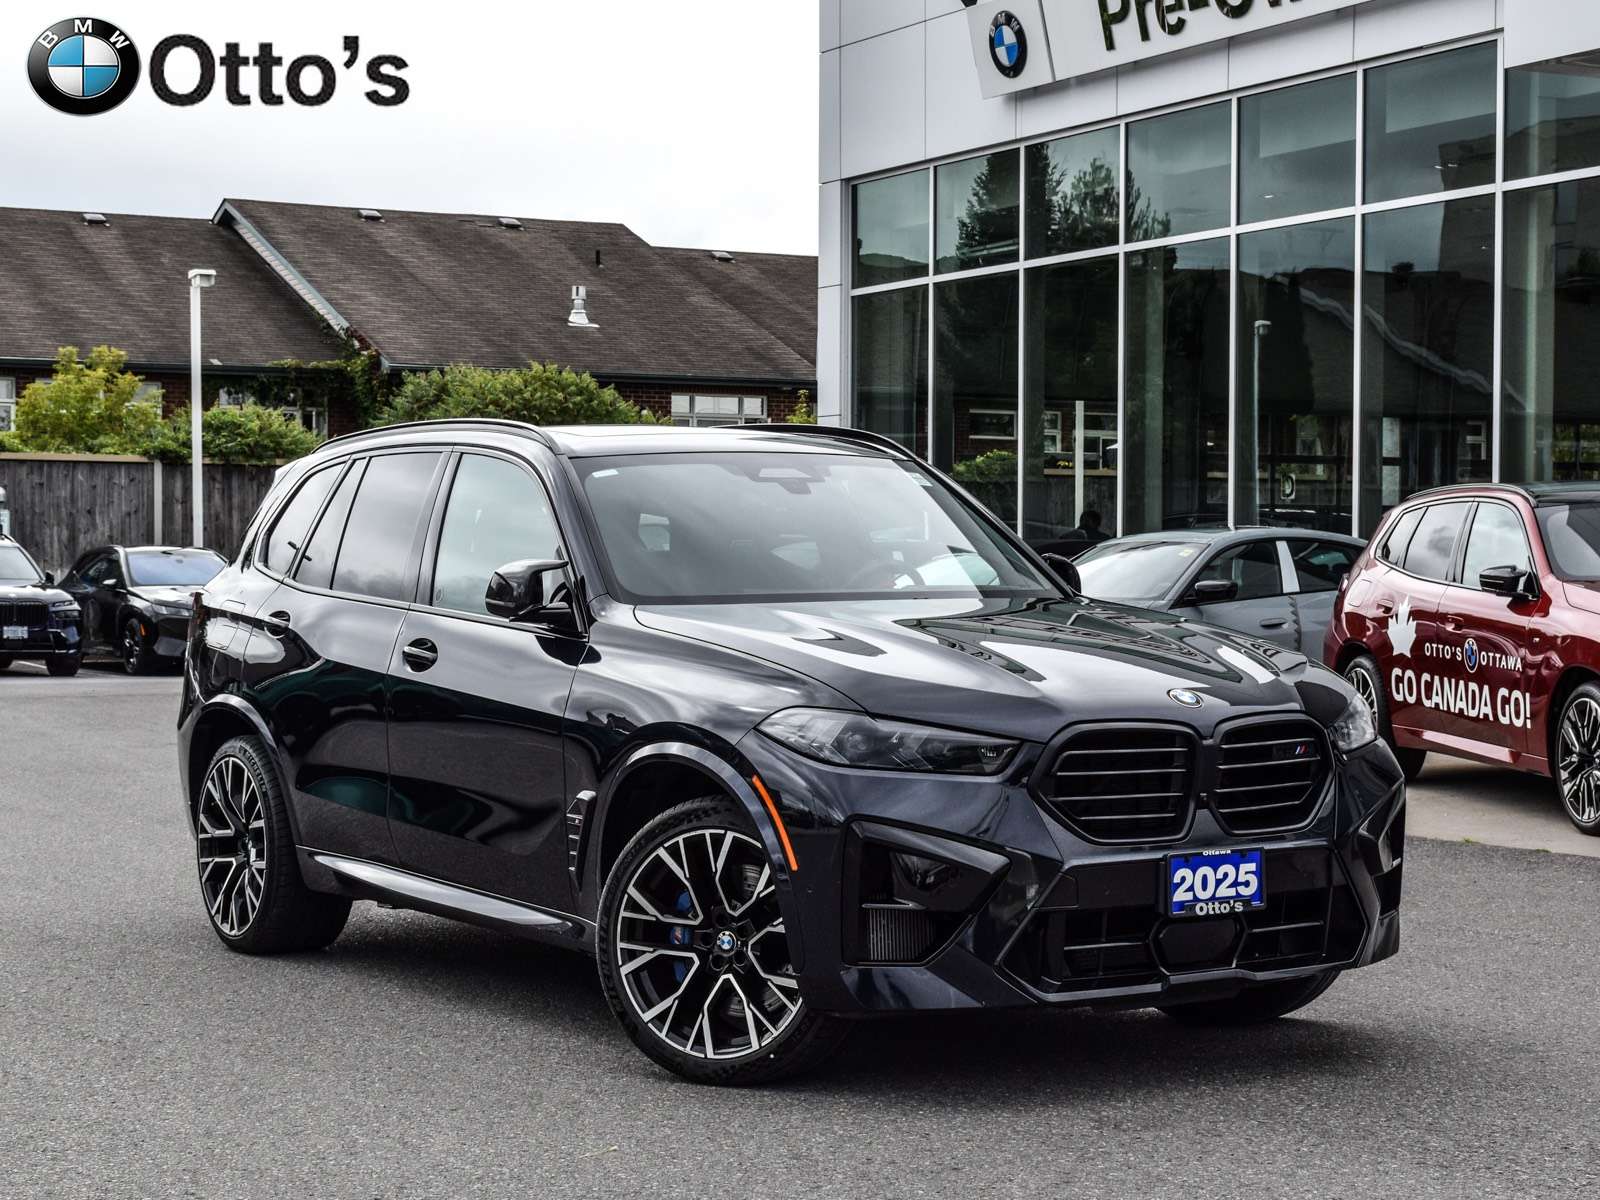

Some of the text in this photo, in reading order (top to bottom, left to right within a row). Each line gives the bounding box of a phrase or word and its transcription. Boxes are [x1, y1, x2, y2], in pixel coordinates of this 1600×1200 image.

[1424, 642, 1462, 662] OTTO'S
[1480, 651, 1522, 672] OTTAWA
[1391, 667, 1532, 729] GO CANADA GO!
[1172, 862, 1258, 902] 2025
[1195, 900, 1244, 916] Otto's
